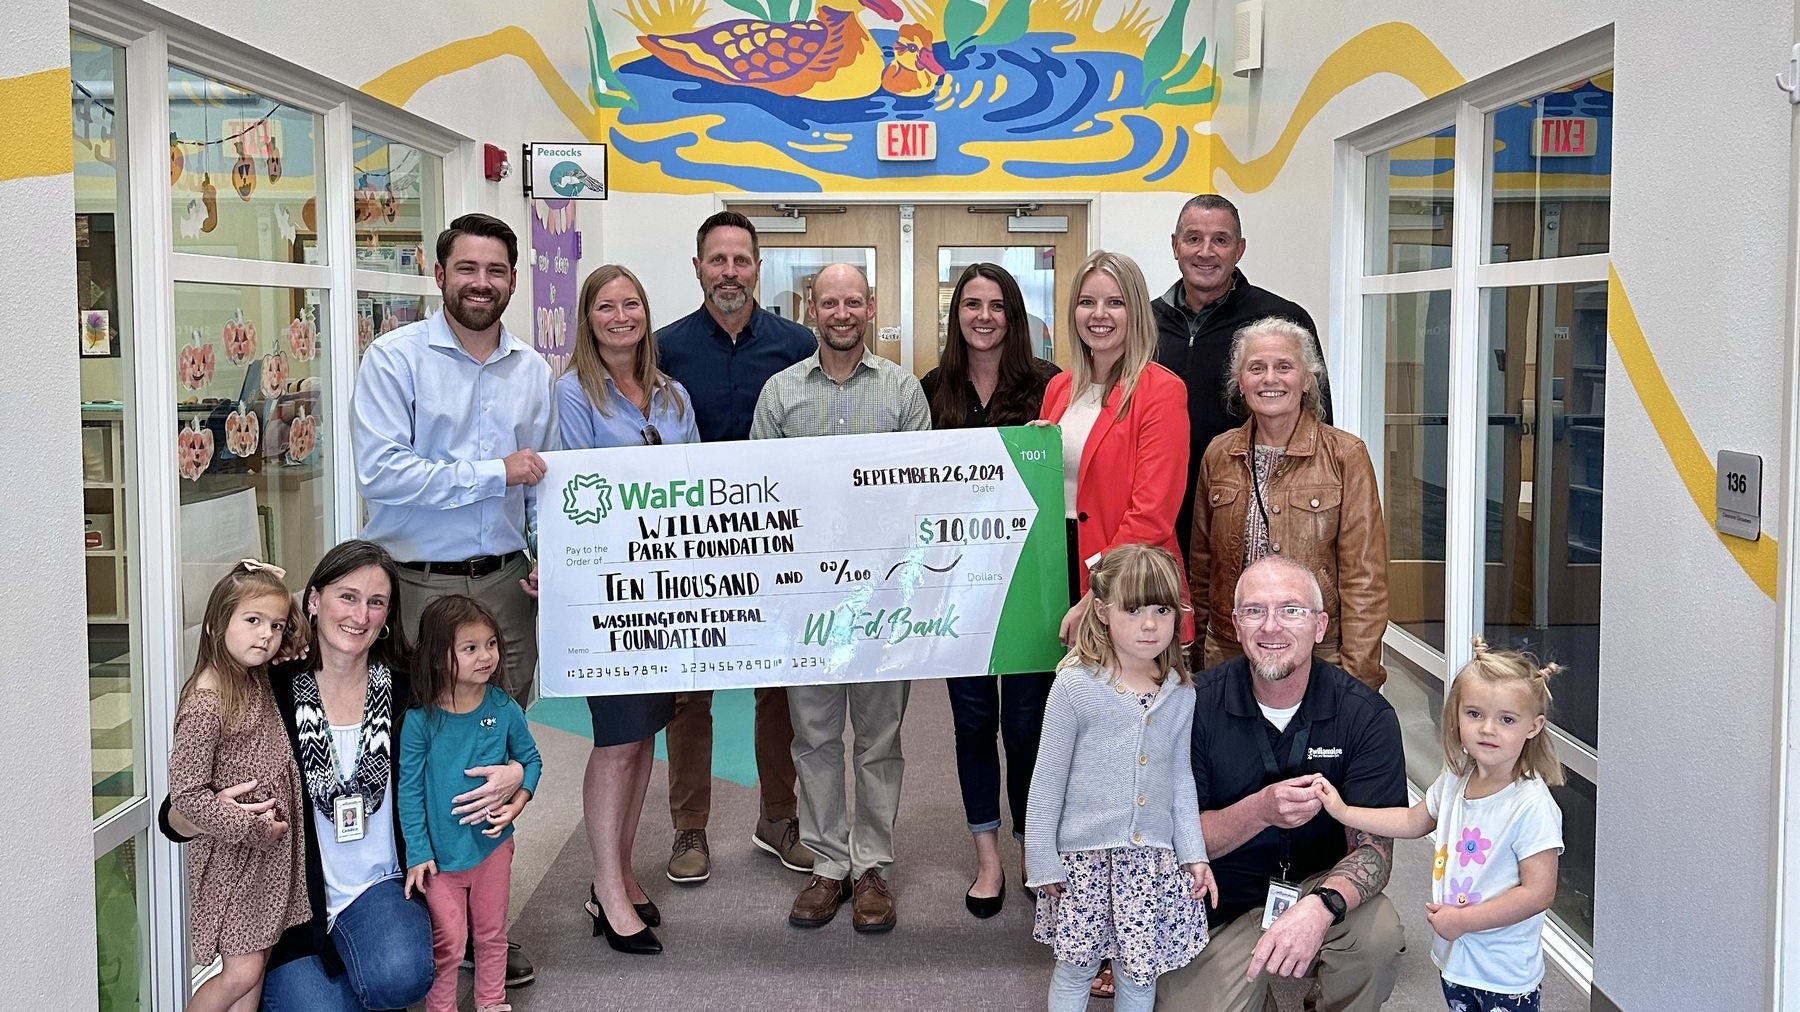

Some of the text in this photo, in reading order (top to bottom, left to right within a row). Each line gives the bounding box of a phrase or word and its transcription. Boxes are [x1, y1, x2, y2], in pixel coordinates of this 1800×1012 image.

[888, 124, 929, 156] EXIT
[537, 147, 582, 157] Peacocks
[1020, 450, 1046, 460] 1001
[618, 476, 780, 510] WaFd Bank
[972, 484, 995, 493] Date
[1727, 471, 1747, 493] 136
[638, 508, 804, 540] WILLAMALANE
[566, 545, 608, 556] Pay to the
[628, 534, 794, 562] PARK FOUNDATION
[566, 556, 603, 567] Order of
[598, 573, 644, 602] TEN
[649, 570, 760, 600] THOUSAND
[776, 571, 803, 585] AND
[967, 571, 1003, 582] Dollars
[592, 608, 766, 630] WASHINGTON FEDERAL
[887, 603, 961, 645] Bank
[610, 627, 726, 652] FOUNDATION
[567, 647, 589, 655] Memo
